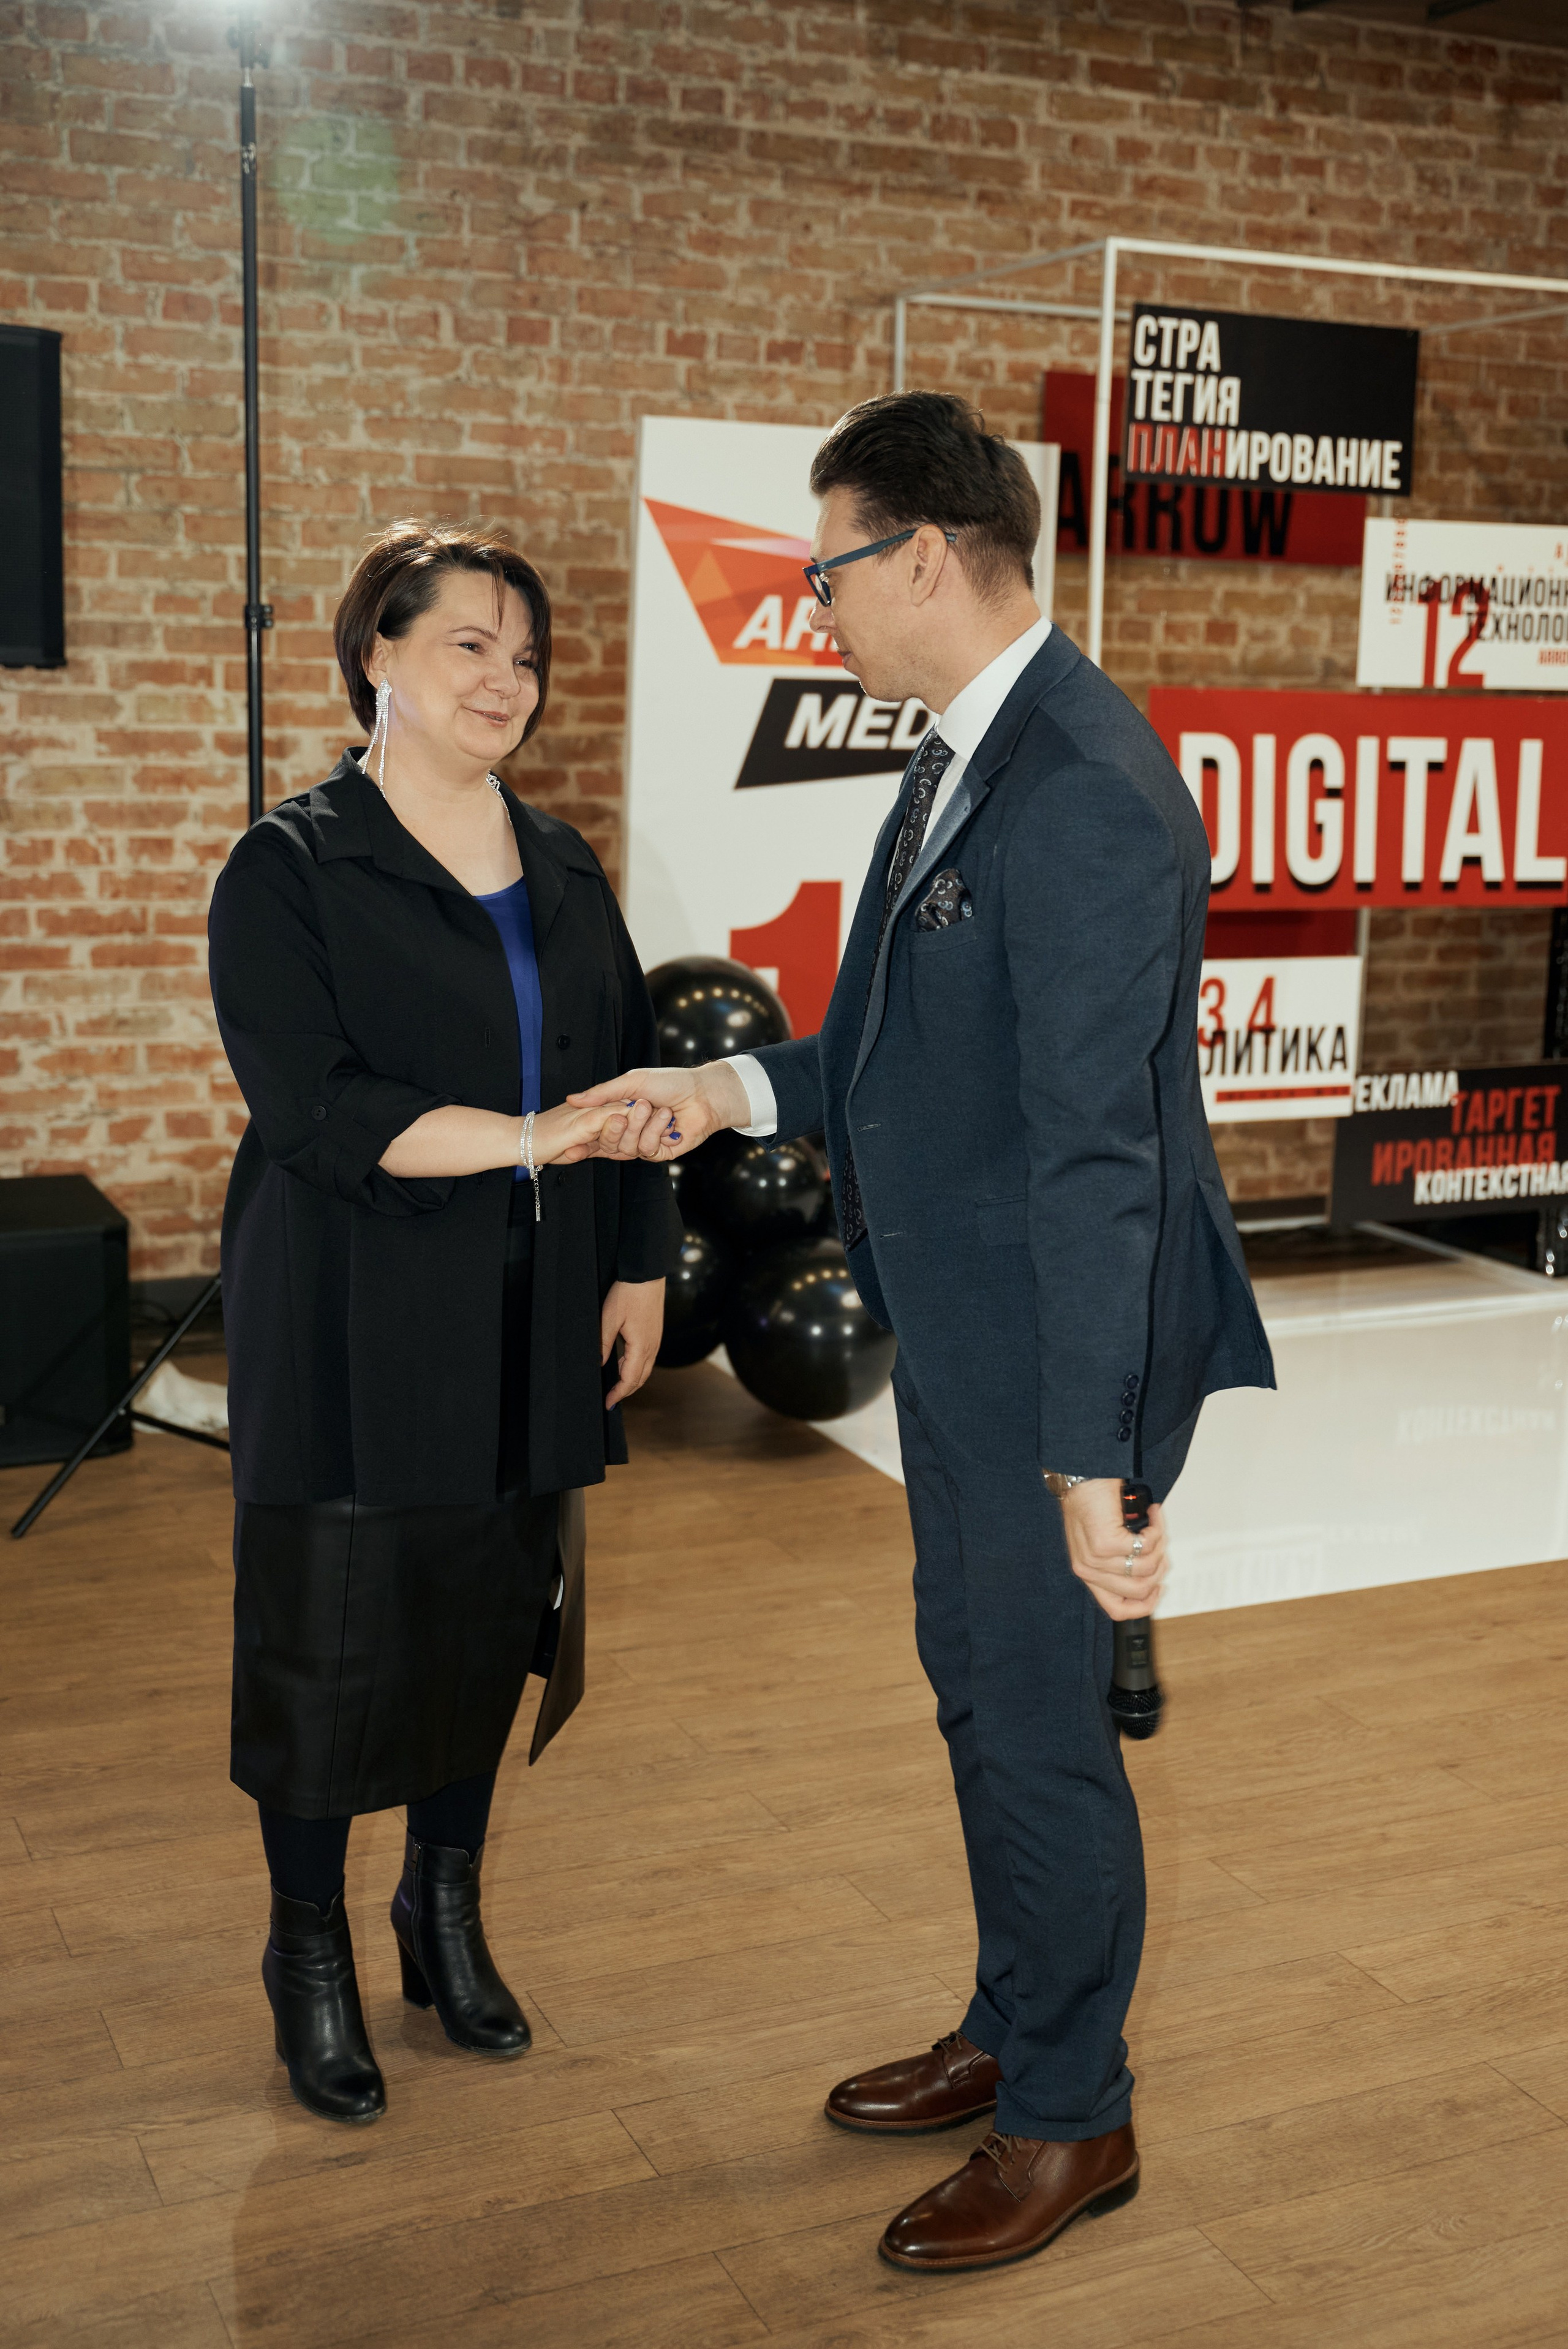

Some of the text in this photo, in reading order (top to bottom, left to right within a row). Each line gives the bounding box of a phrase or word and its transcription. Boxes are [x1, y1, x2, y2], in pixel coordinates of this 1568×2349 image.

[1134, 314, 1221, 372] СТРА
[1131, 369, 1241, 427] ТЕГИЯ
[1127, 423, 1403, 489] ПЛАНИРОВАНИЕ
[1418, 582, 1490, 688] 12
[1180, 733, 1566, 893] DIGITAL
[1451, 1084, 1561, 1134] ТАРГЕТ
